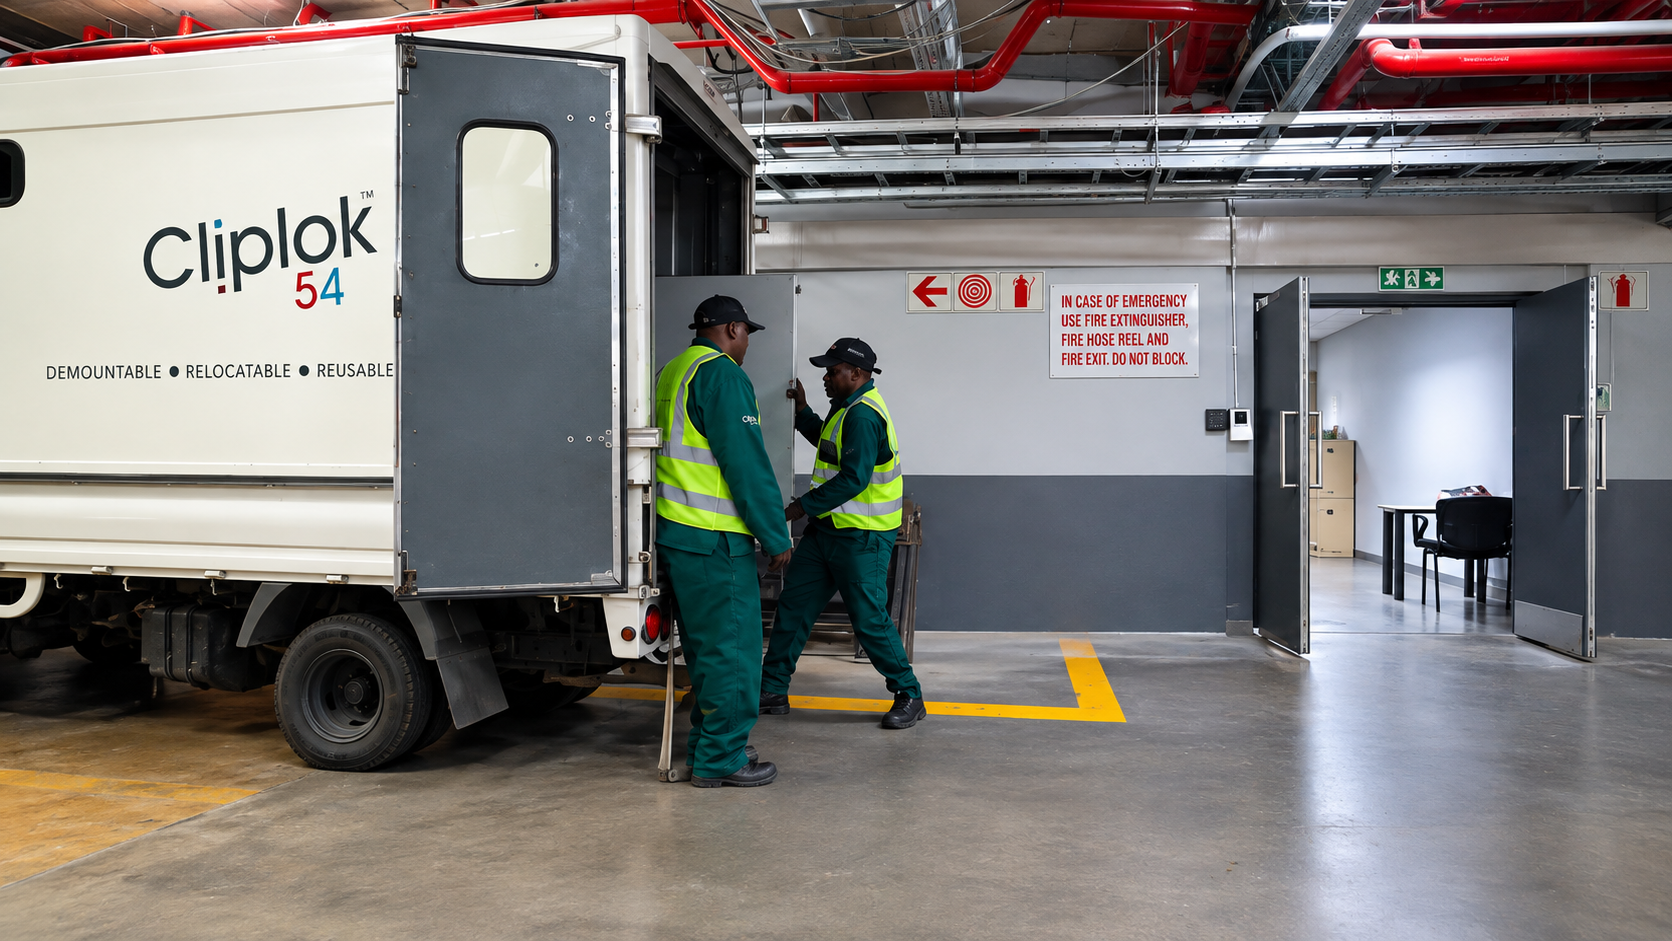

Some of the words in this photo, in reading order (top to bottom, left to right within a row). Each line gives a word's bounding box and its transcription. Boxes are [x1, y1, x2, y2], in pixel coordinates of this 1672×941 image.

[143, 195, 377, 294] Cliplok
[360, 190, 374, 200] TM
[295, 267, 344, 309] 54
[1061, 295, 1072, 308] IN
[1075, 295, 1103, 308] CASE
[1106, 295, 1120, 308] OF
[1122, 294, 1187, 308] EMERGENCY
[1061, 314, 1081, 327] USE
[1084, 314, 1107, 327] FIRE
[1110, 313, 1188, 328] EXTINGUISHER,
[1061, 333, 1084, 346] FIRE
[1087, 333, 1115, 346] HOSE
[1118, 333, 1144, 346] REEL
[1147, 332, 1169, 346] AND
[1061, 352, 1083, 365] FIRE
[1086, 352, 1109, 365] EXIT.
[1112, 352, 1126, 365] DO
[1129, 352, 1150, 365] NOT
[1152, 352, 1188, 365] BLOCK.
[46, 364, 162, 380] DEMOUNTABLE
[186, 363, 291, 379] RELOCATABLE
[317, 363, 394, 378] REUSABLE
